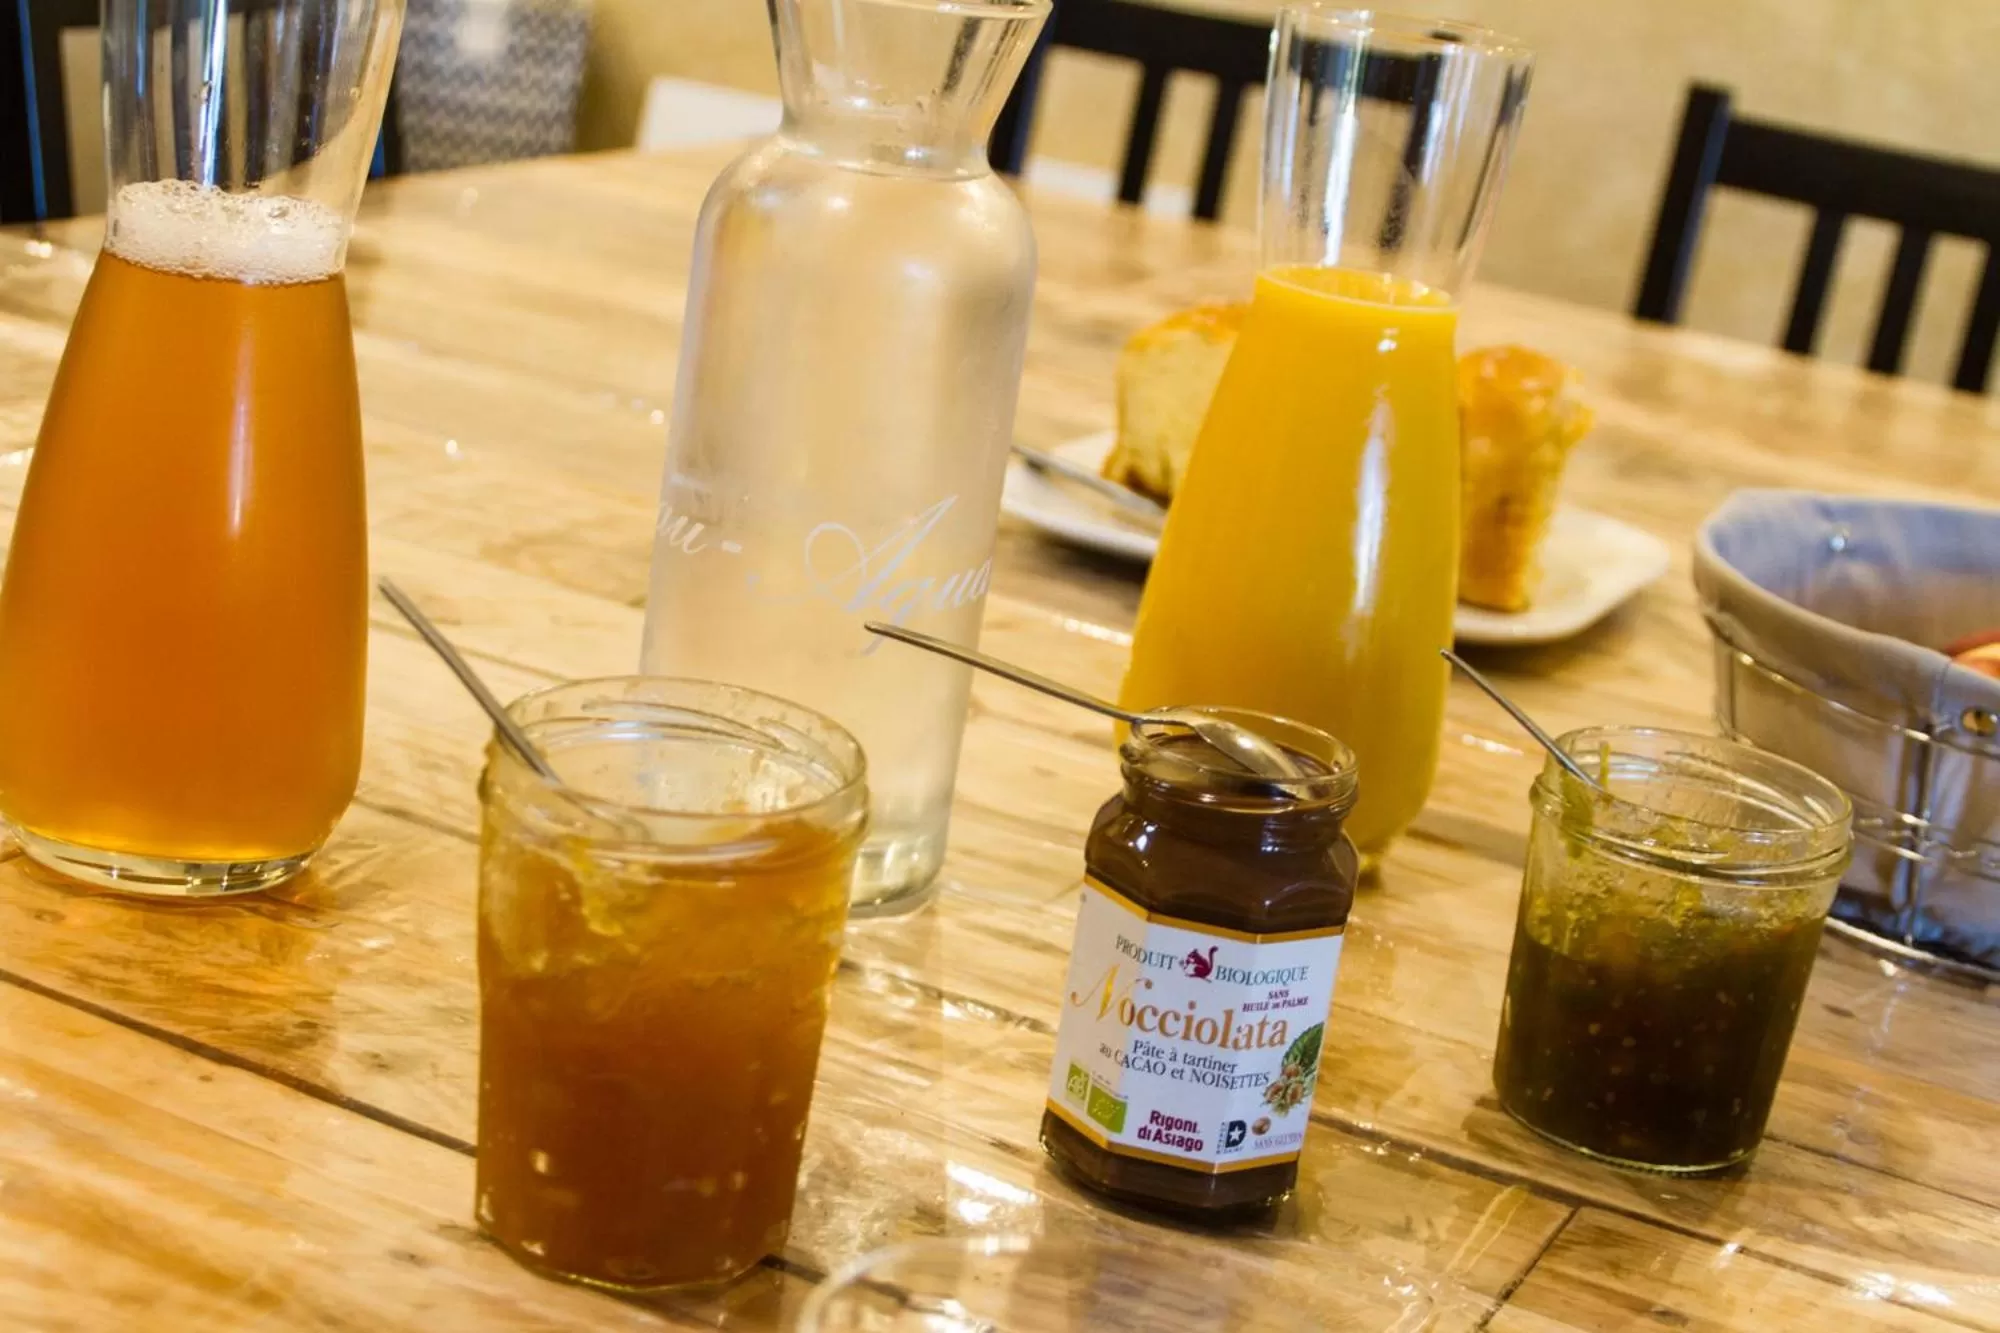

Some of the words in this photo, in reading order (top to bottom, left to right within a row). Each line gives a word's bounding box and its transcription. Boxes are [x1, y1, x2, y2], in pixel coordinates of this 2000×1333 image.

[1115, 935, 1178, 970] PRODUIT
[1215, 965, 1309, 986] BIOLOGIQUE
[1071, 964, 1290, 1051] Nocciolata
[1268, 989, 1290, 999] SANS
[1282, 996, 1308, 1008] PALME
[1114, 1049, 1166, 1076] CACAO
[1171, 1068, 1185, 1081] et
[1189, 1068, 1271, 1090] NOISETTES
[1132, 1039, 1165, 1059] Pâte
[1168, 1047, 1178, 1062] à
[1183, 1051, 1238, 1075] tartiner
[1150, 1110, 1198, 1133] Rigoni
